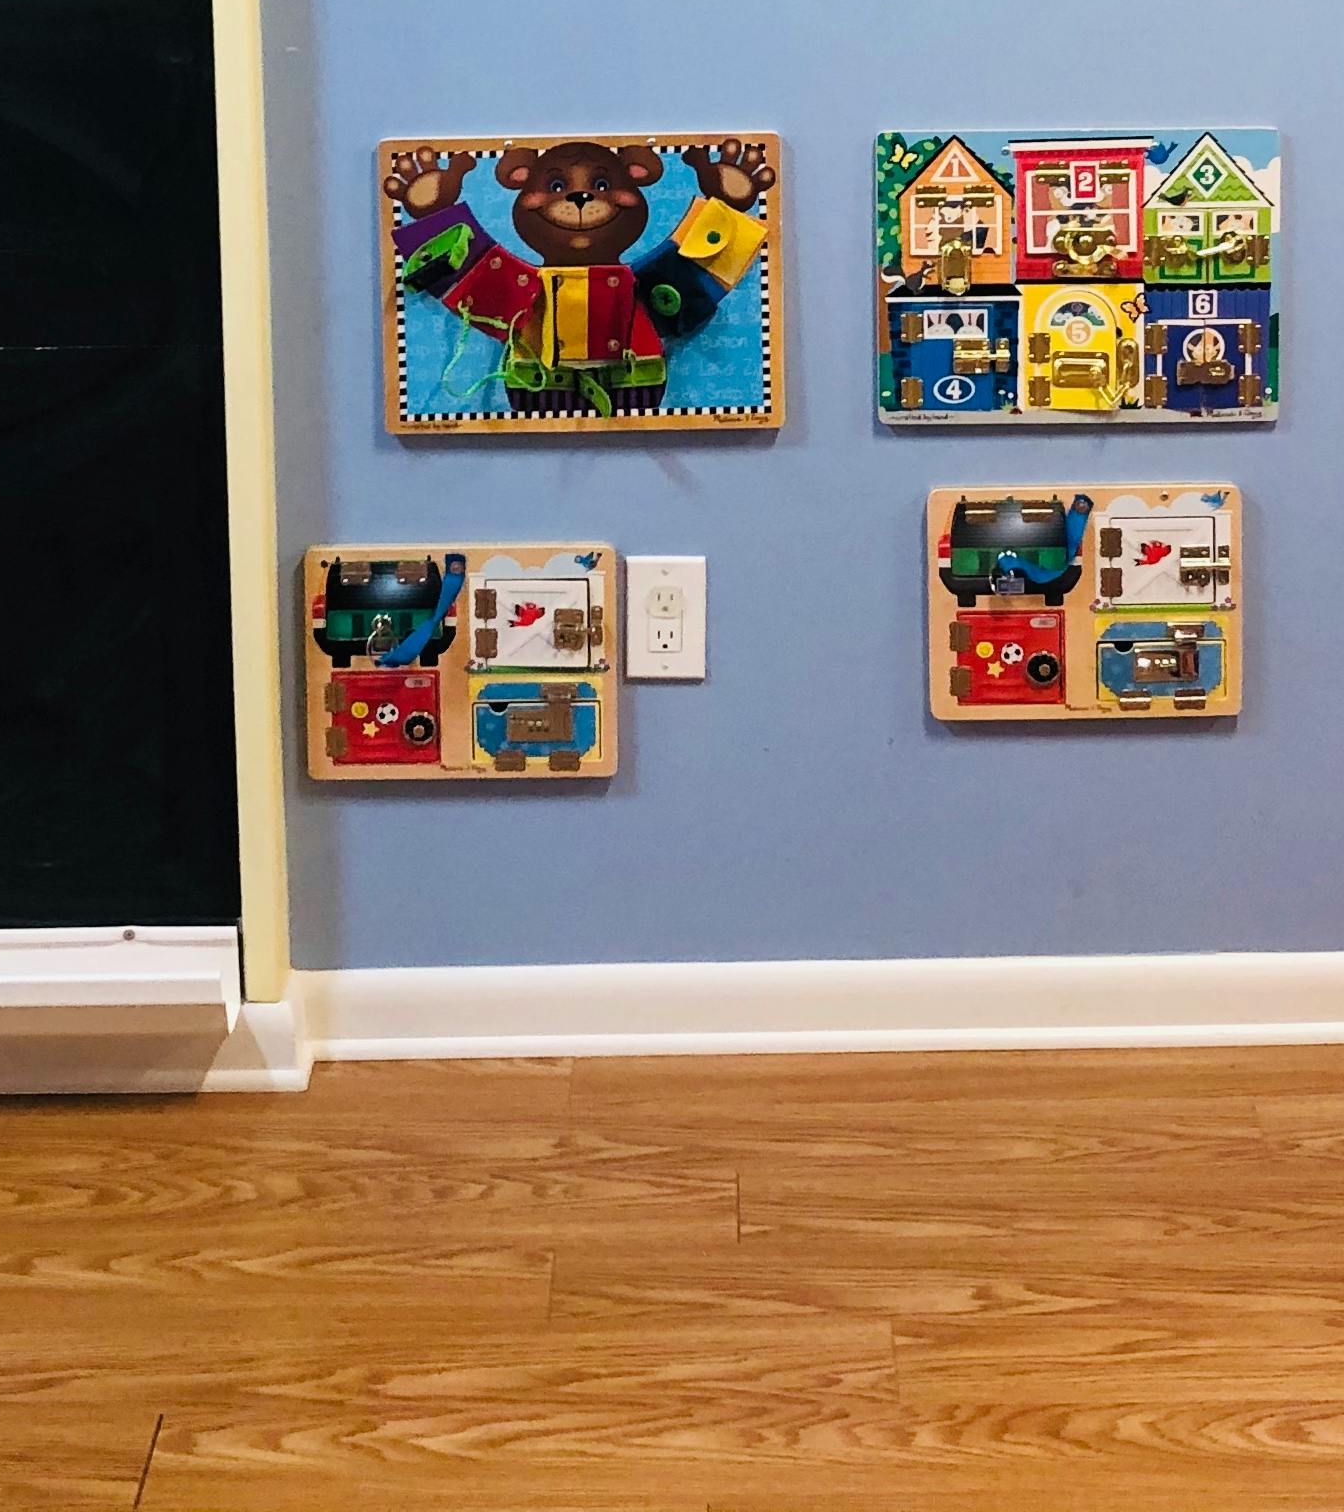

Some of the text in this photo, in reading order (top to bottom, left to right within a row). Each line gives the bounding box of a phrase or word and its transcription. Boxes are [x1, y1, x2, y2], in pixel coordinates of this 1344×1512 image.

[950, 157, 960, 177] 1
[1199, 164, 1214, 185] 3
[1079, 173, 1093, 192] 2
[1194, 294, 1208, 313] 6
[1071, 322, 1086, 339] 5
[946, 380, 962, 398] 4
